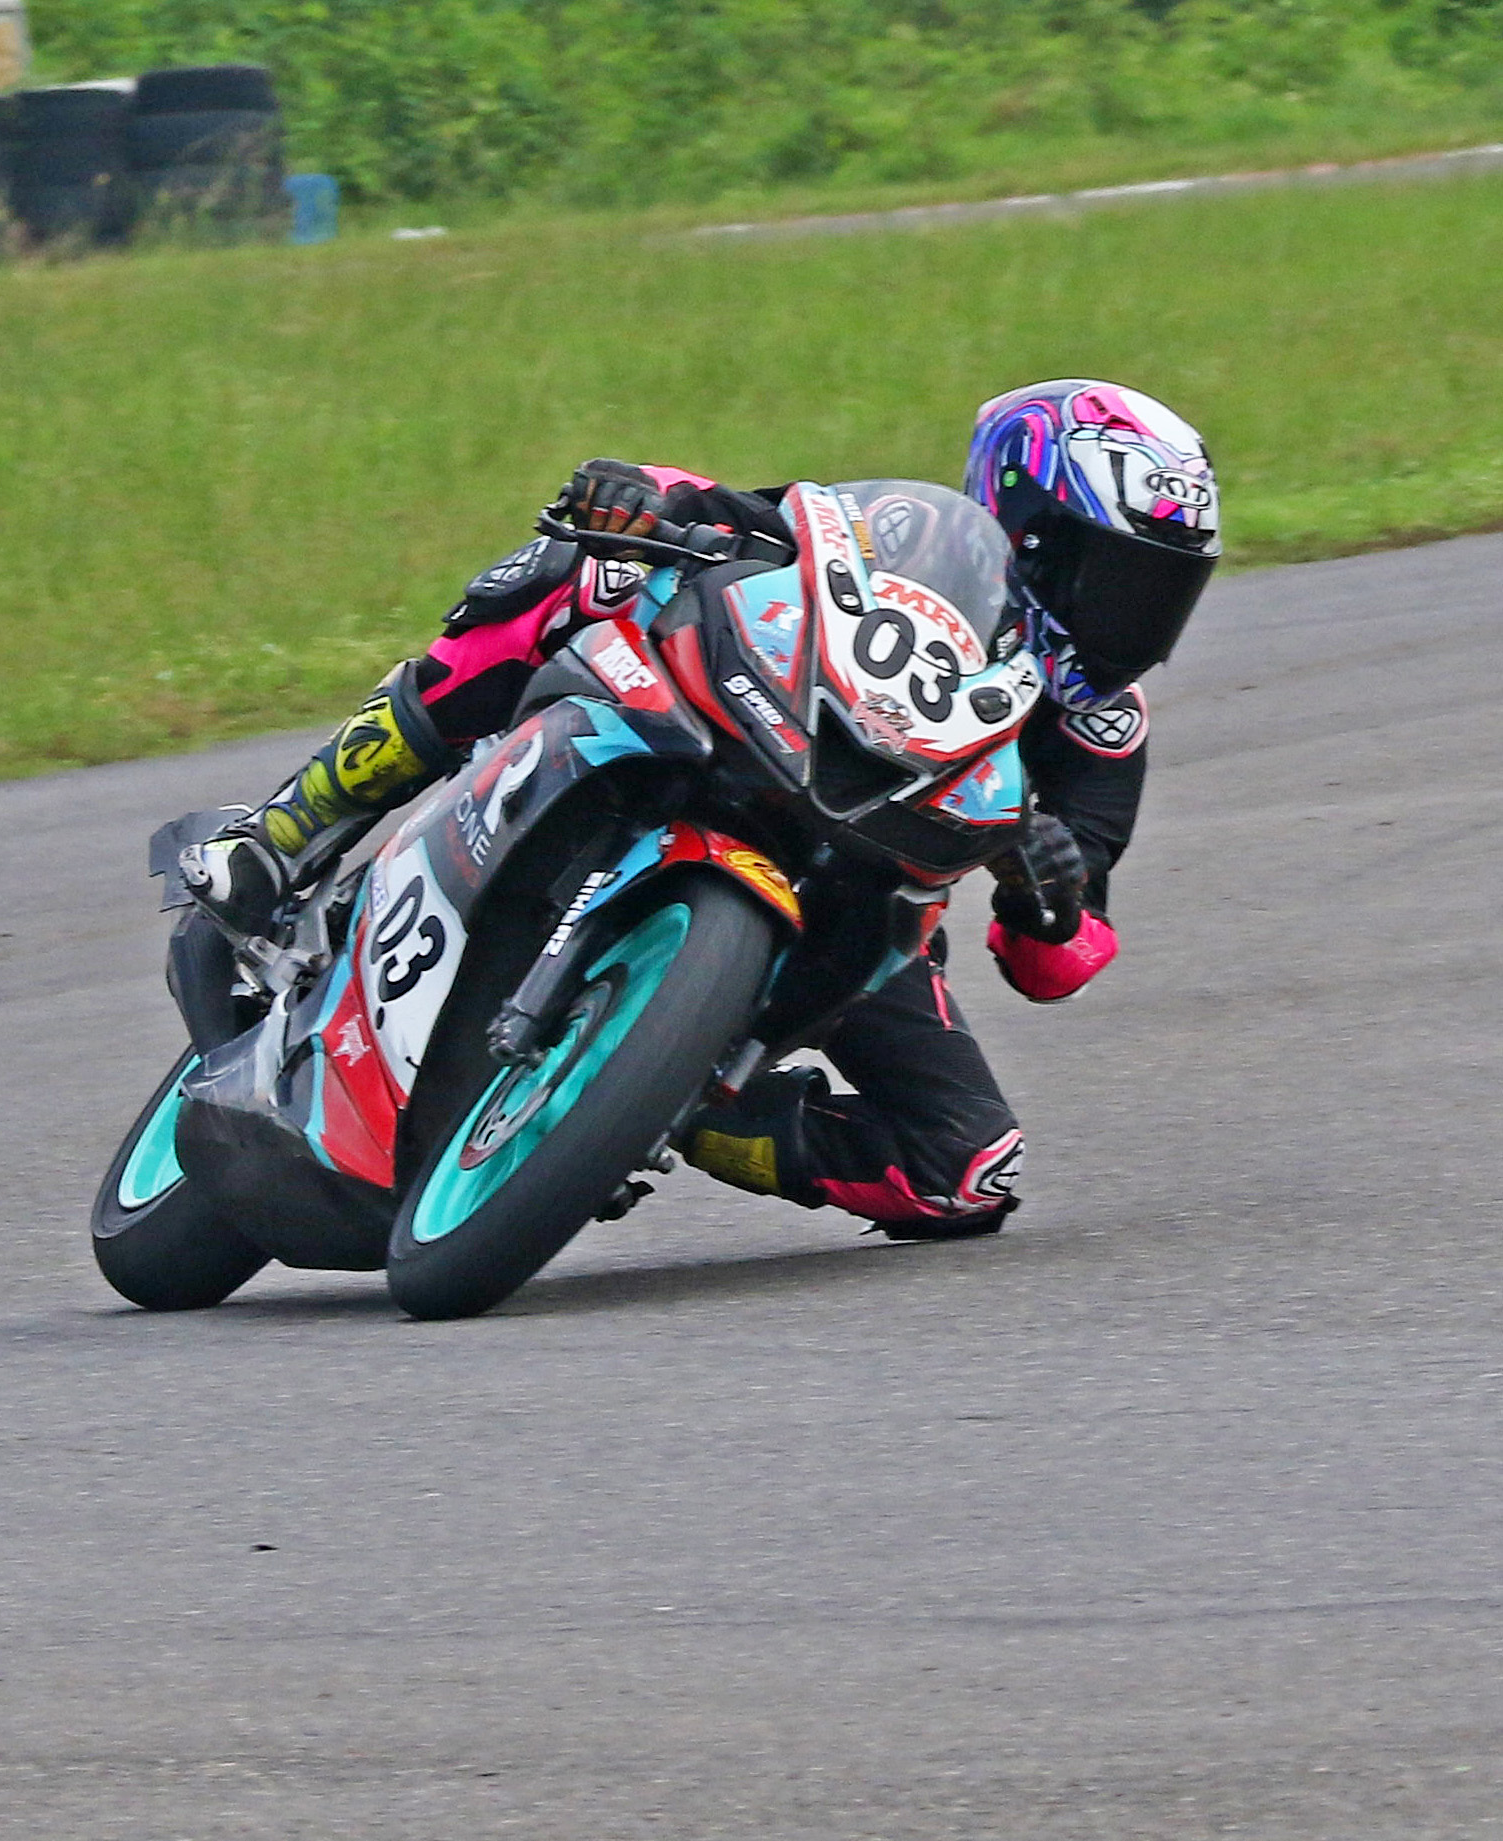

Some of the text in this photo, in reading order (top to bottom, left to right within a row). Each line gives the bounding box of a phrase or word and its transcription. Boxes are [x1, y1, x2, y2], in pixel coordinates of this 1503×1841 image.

[875, 579, 983, 660] MRF
[592, 636, 658, 693] MRF
[853, 607, 961, 723] 03
[455, 790, 492, 867] ONE
[371, 875, 446, 1003] 03
